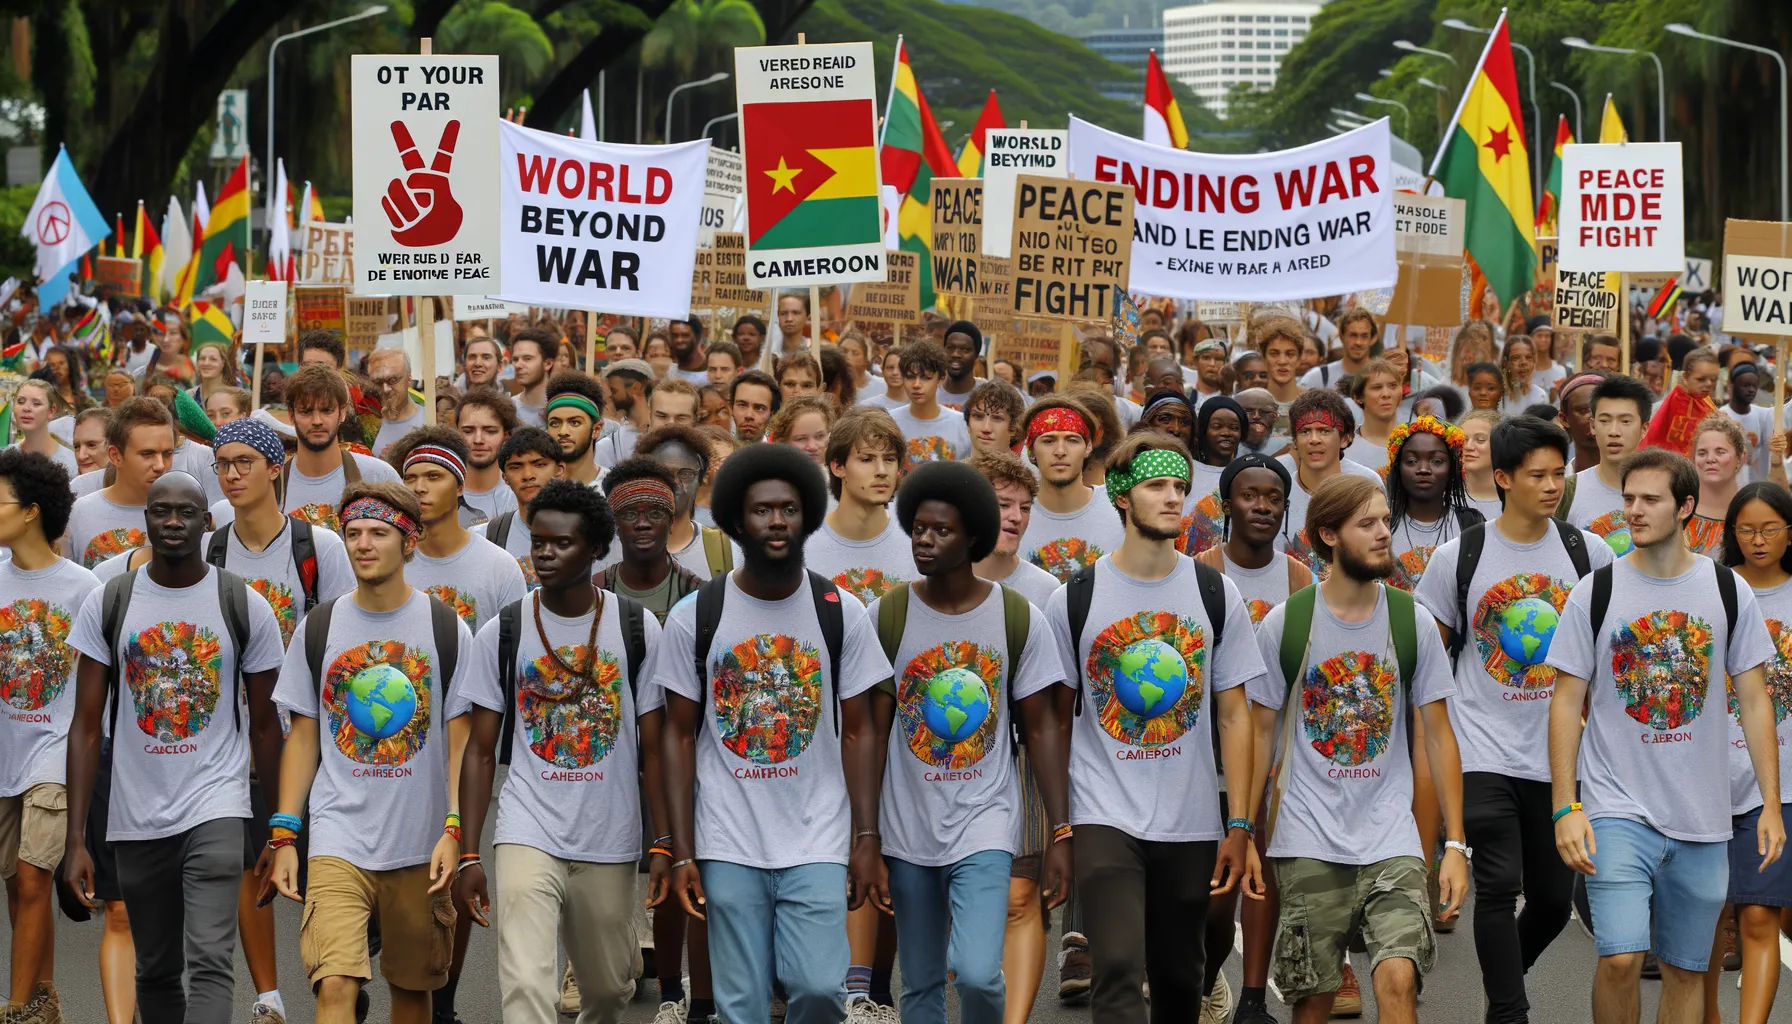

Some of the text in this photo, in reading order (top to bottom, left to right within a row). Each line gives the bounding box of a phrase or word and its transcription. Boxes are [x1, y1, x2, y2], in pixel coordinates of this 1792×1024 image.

[420, 66, 483, 84] YOUR
[402, 92, 450, 111] PAR
[517, 153, 673, 204] WORLD
[1095, 154, 1380, 214] ENDING WAR
[1579, 168, 1664, 189] PEACE
[1018, 184, 1123, 227] PEACE
[1581, 193, 1662, 221] MDE
[521, 205, 665, 242] BEYOND
[1186, 228, 1215, 251] LE
[1318, 210, 1372, 242] WAR
[1580, 226, 1658, 247] FIGHT
[368, 270, 387, 281] DE
[536, 244, 640, 291] WAR
[753, 255, 879, 279] CAMEROON
[934, 256, 977, 295] WAR
[1019, 254, 1045, 273] BE
[1015, 277, 1110, 317] FIGHT
[1741, 295, 1792, 325] WA
